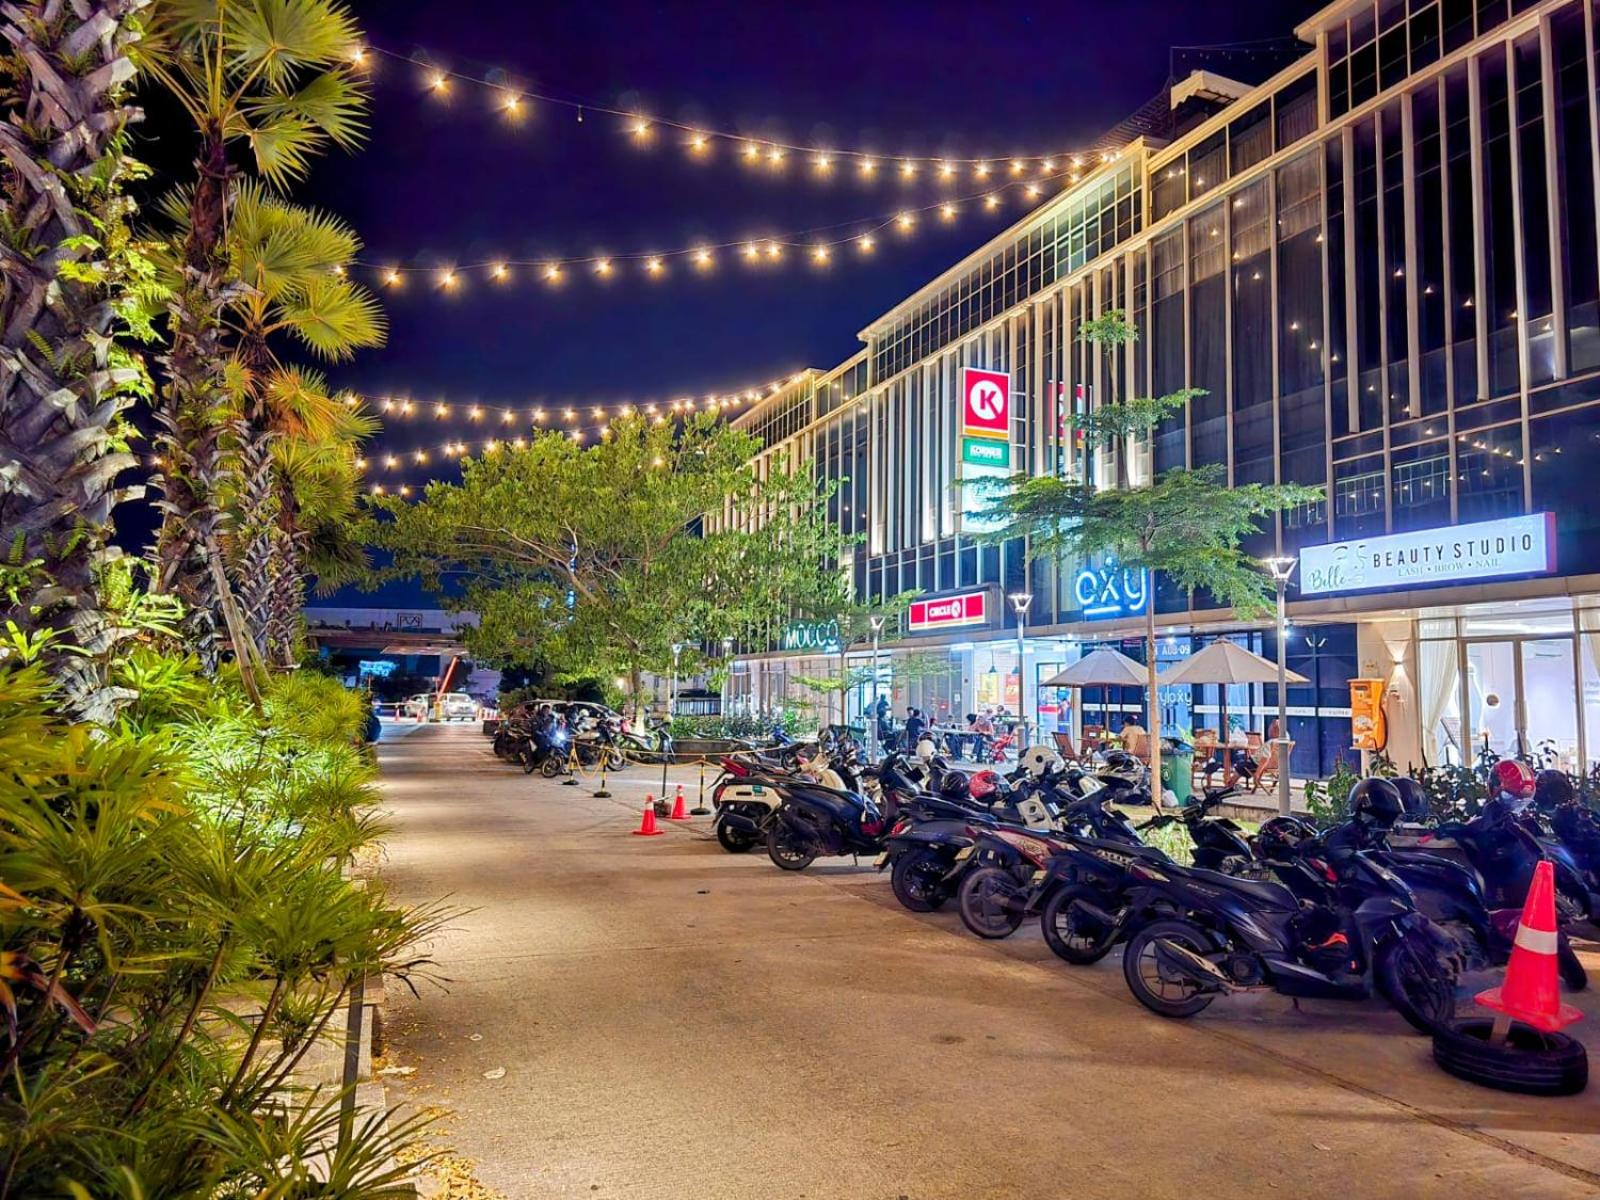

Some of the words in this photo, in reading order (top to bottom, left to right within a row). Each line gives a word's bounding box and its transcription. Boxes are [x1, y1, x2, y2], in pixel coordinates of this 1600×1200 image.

[978, 387, 1001, 419] K
[1373, 545, 1444, 568] BEAUTY
[1454, 534, 1532, 558] STUDIO
[1308, 565, 1347, 591] Belle
[1397, 566, 1425, 577] LASH
[1434, 562, 1464, 573] BROW
[1475, 559, 1501, 569] NAIL
[1075, 567, 1147, 611] oxy
